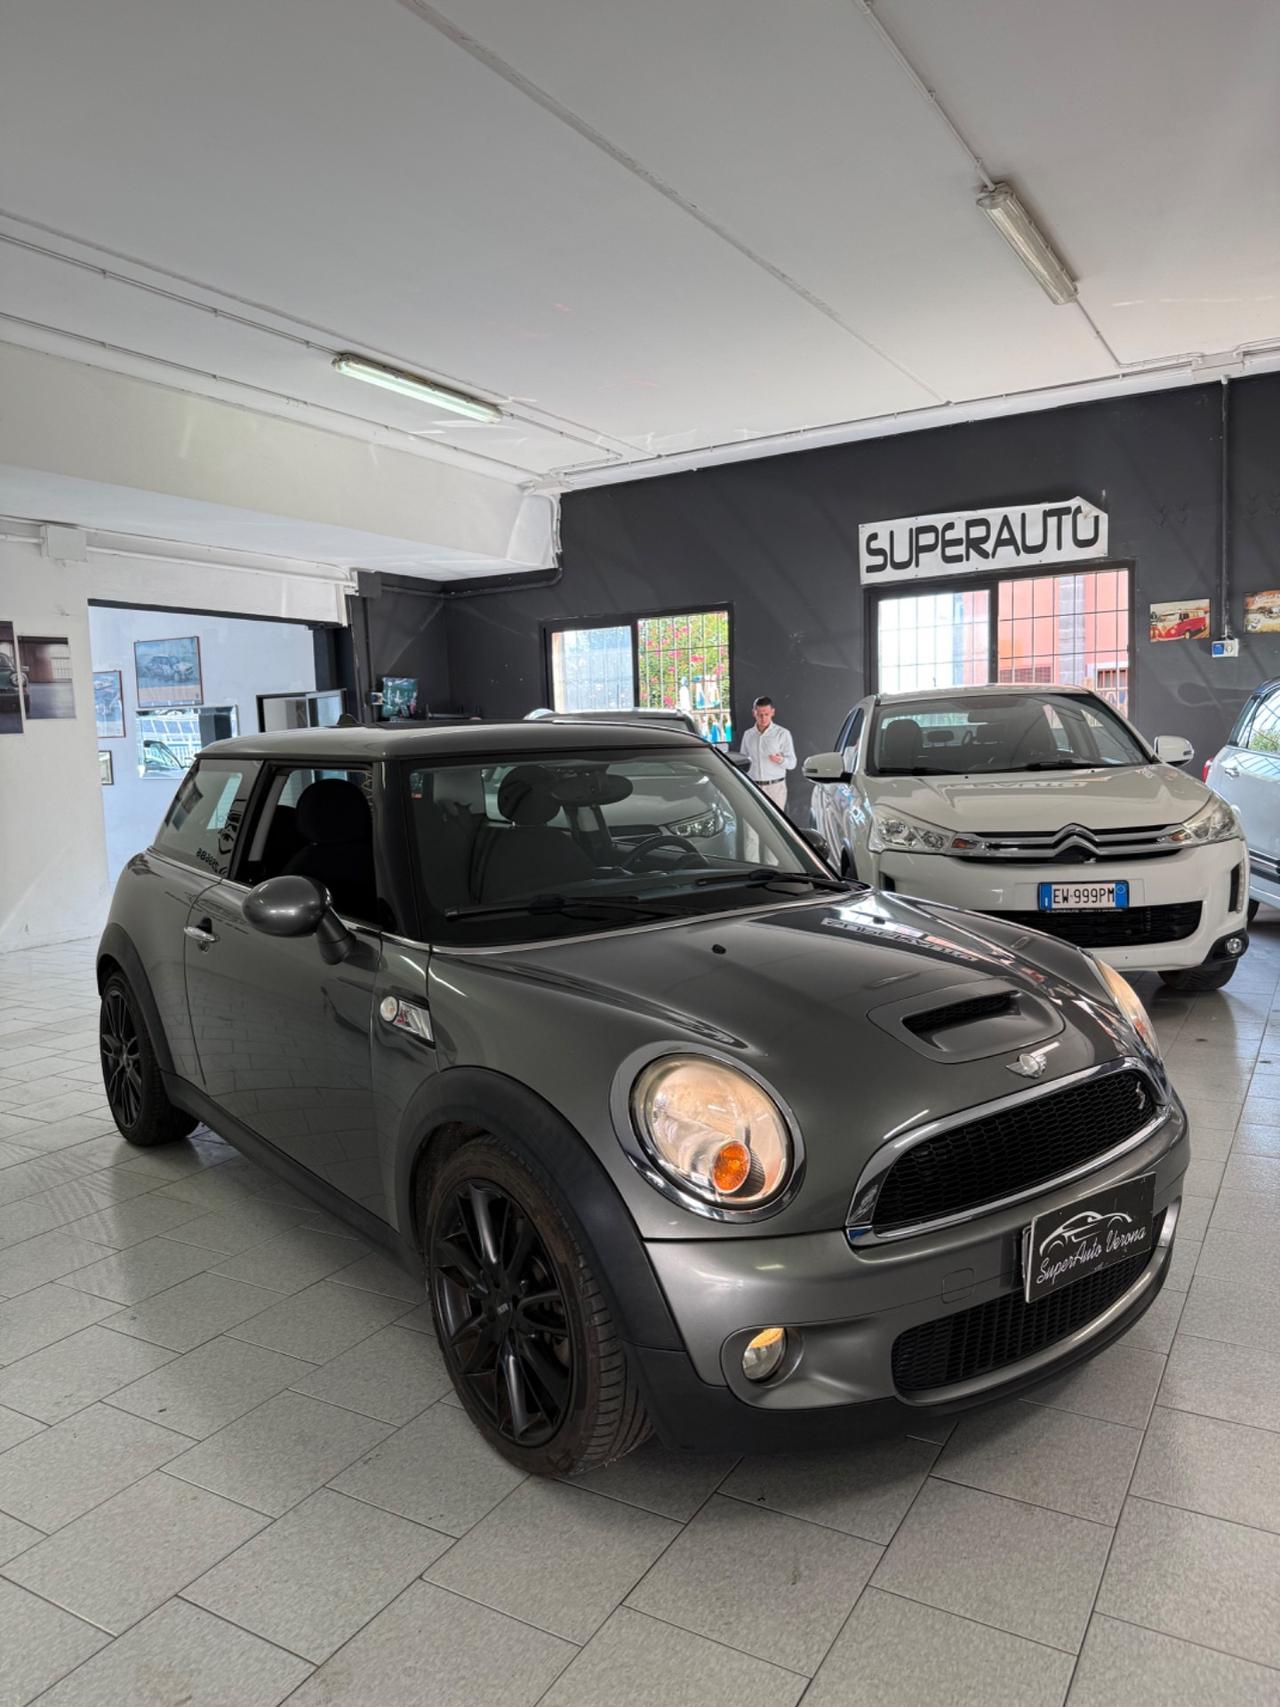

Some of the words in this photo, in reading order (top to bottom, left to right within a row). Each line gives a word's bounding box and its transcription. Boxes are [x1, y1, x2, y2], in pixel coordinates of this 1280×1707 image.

[866, 505, 1100, 573] SUPERAUTO
[1036, 1237, 1102, 1285] SuperAuto
[1106, 1226, 1146, 1253] Verona
